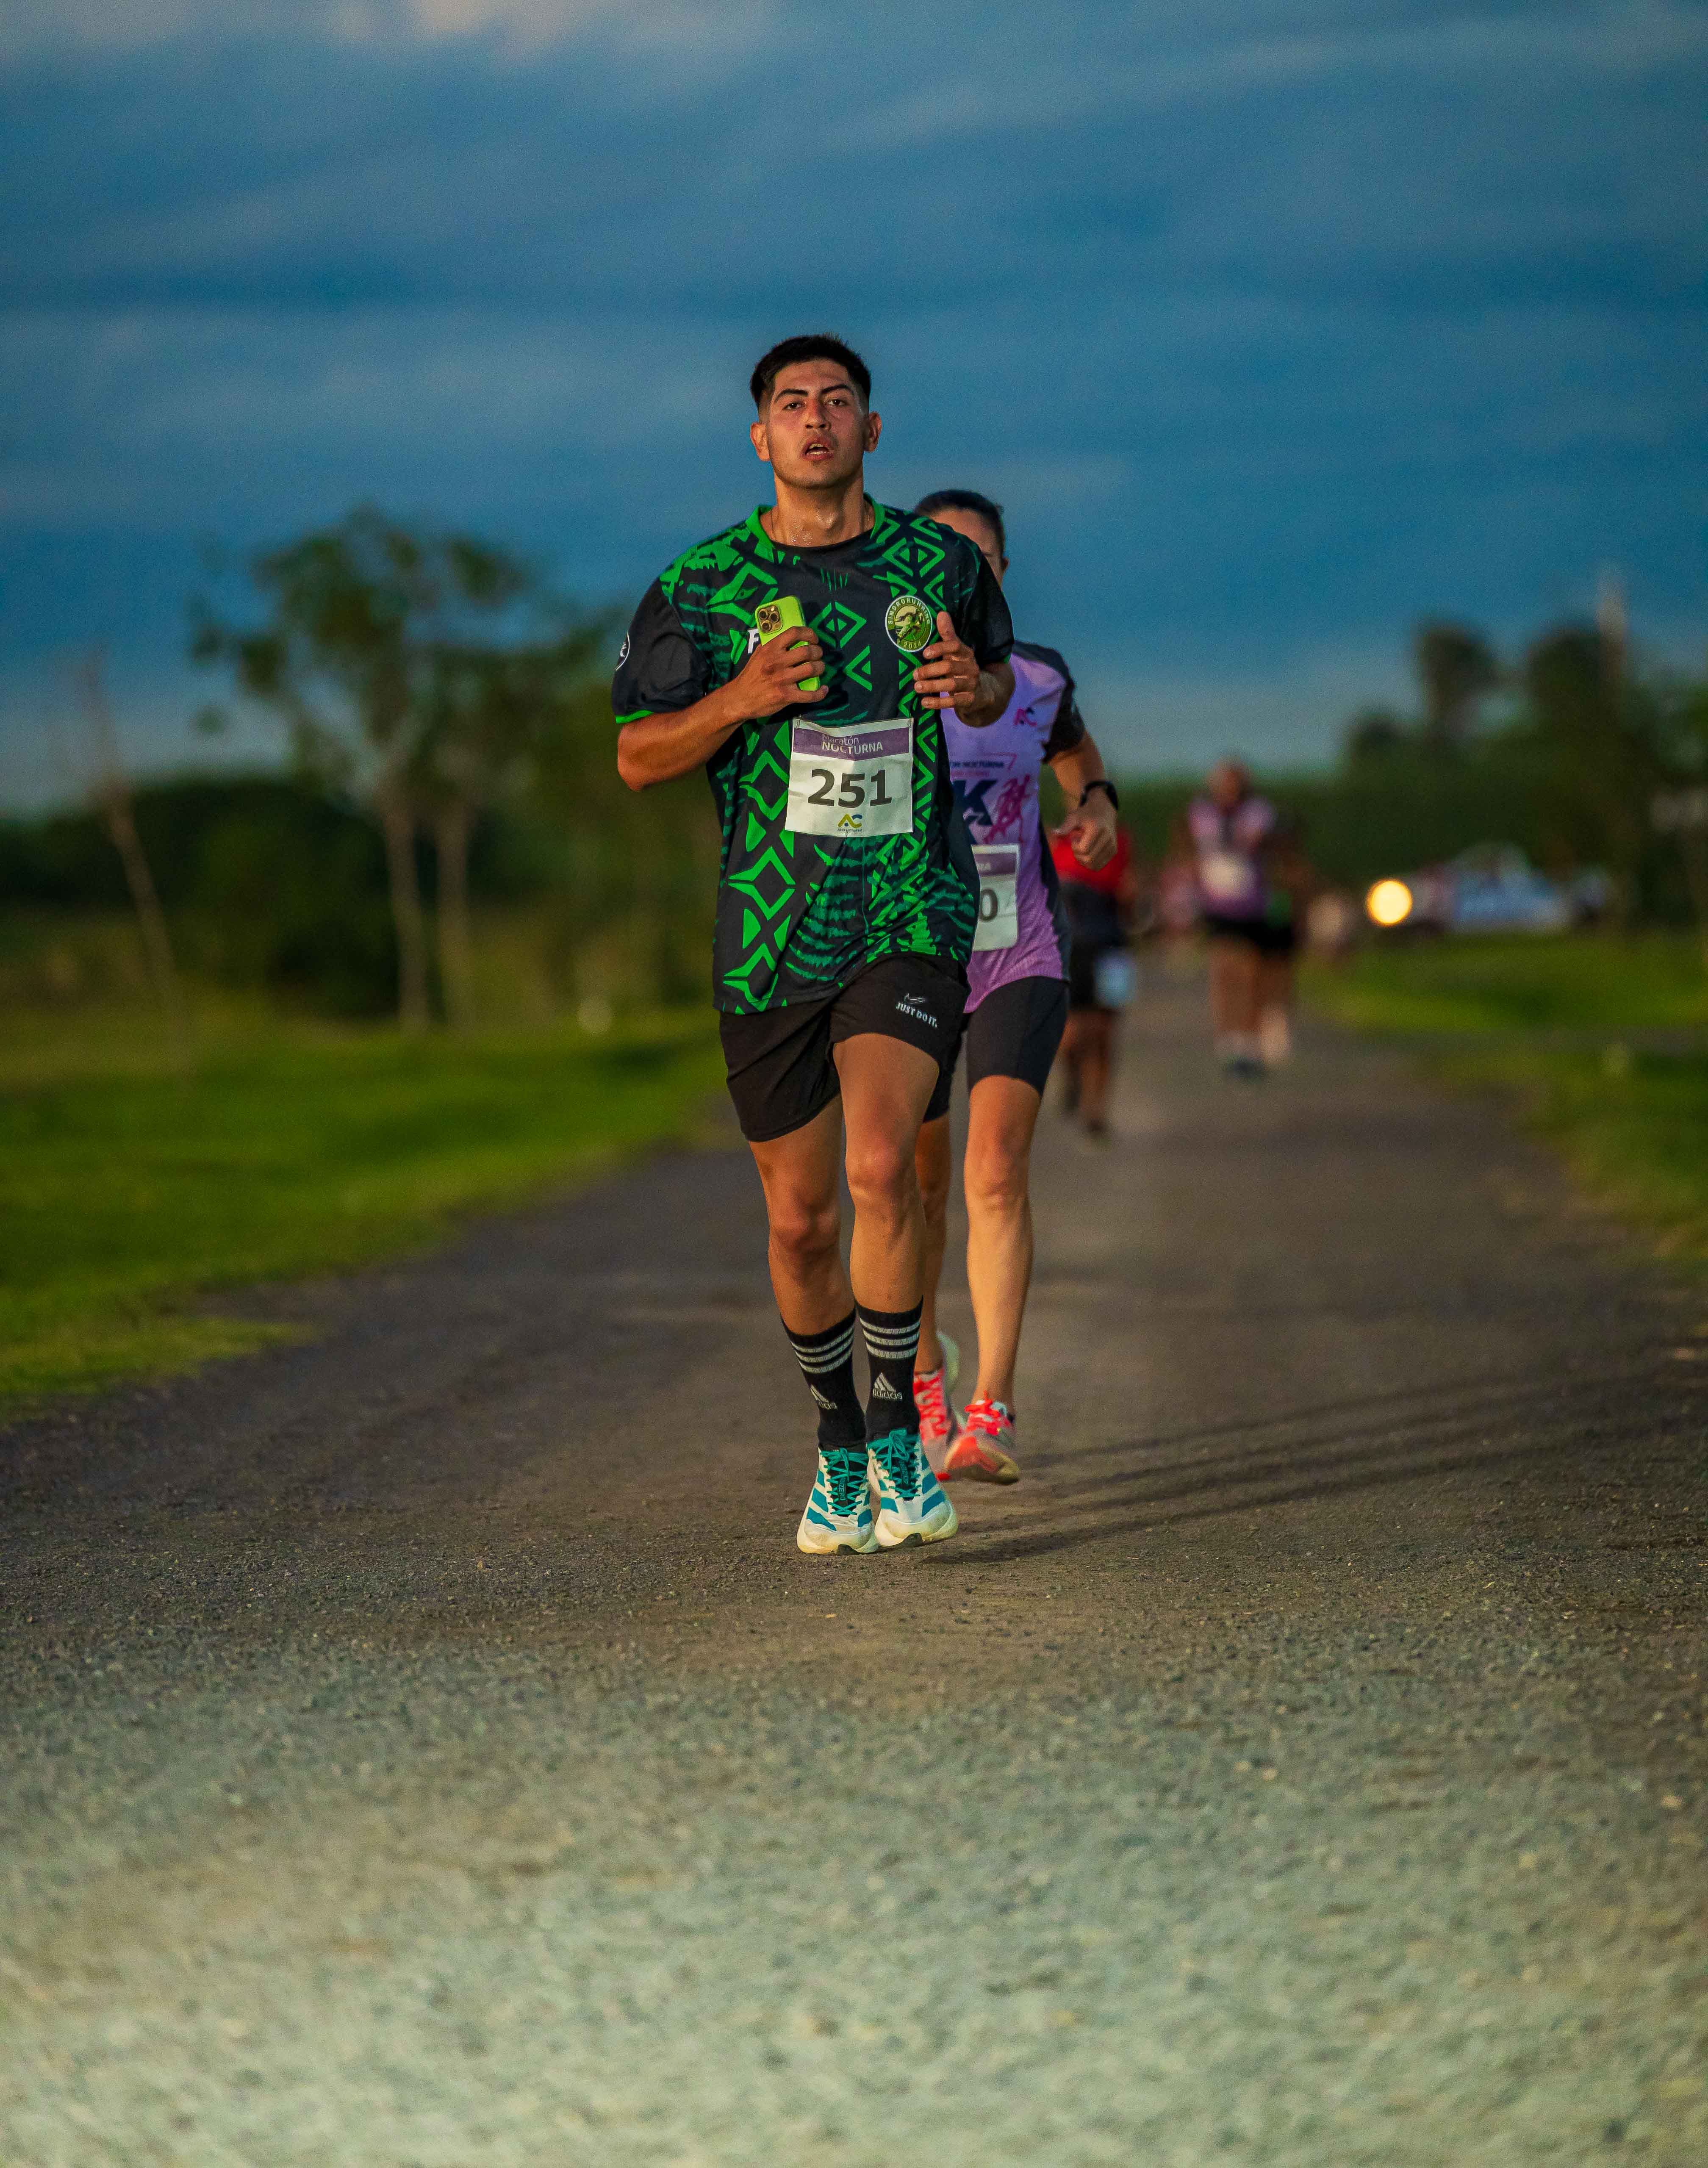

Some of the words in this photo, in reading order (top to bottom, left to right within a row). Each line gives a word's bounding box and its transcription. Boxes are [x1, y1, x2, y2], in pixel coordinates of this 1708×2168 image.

[822, 732, 859, 746] Maratón
[821, 741, 883, 755] NOCTURNA
[808, 769, 892, 808] 251
[895, 1002, 915, 1017] JUST
[916, 1009, 928, 1022] DO
[873, 1388, 902, 1400] adidas
